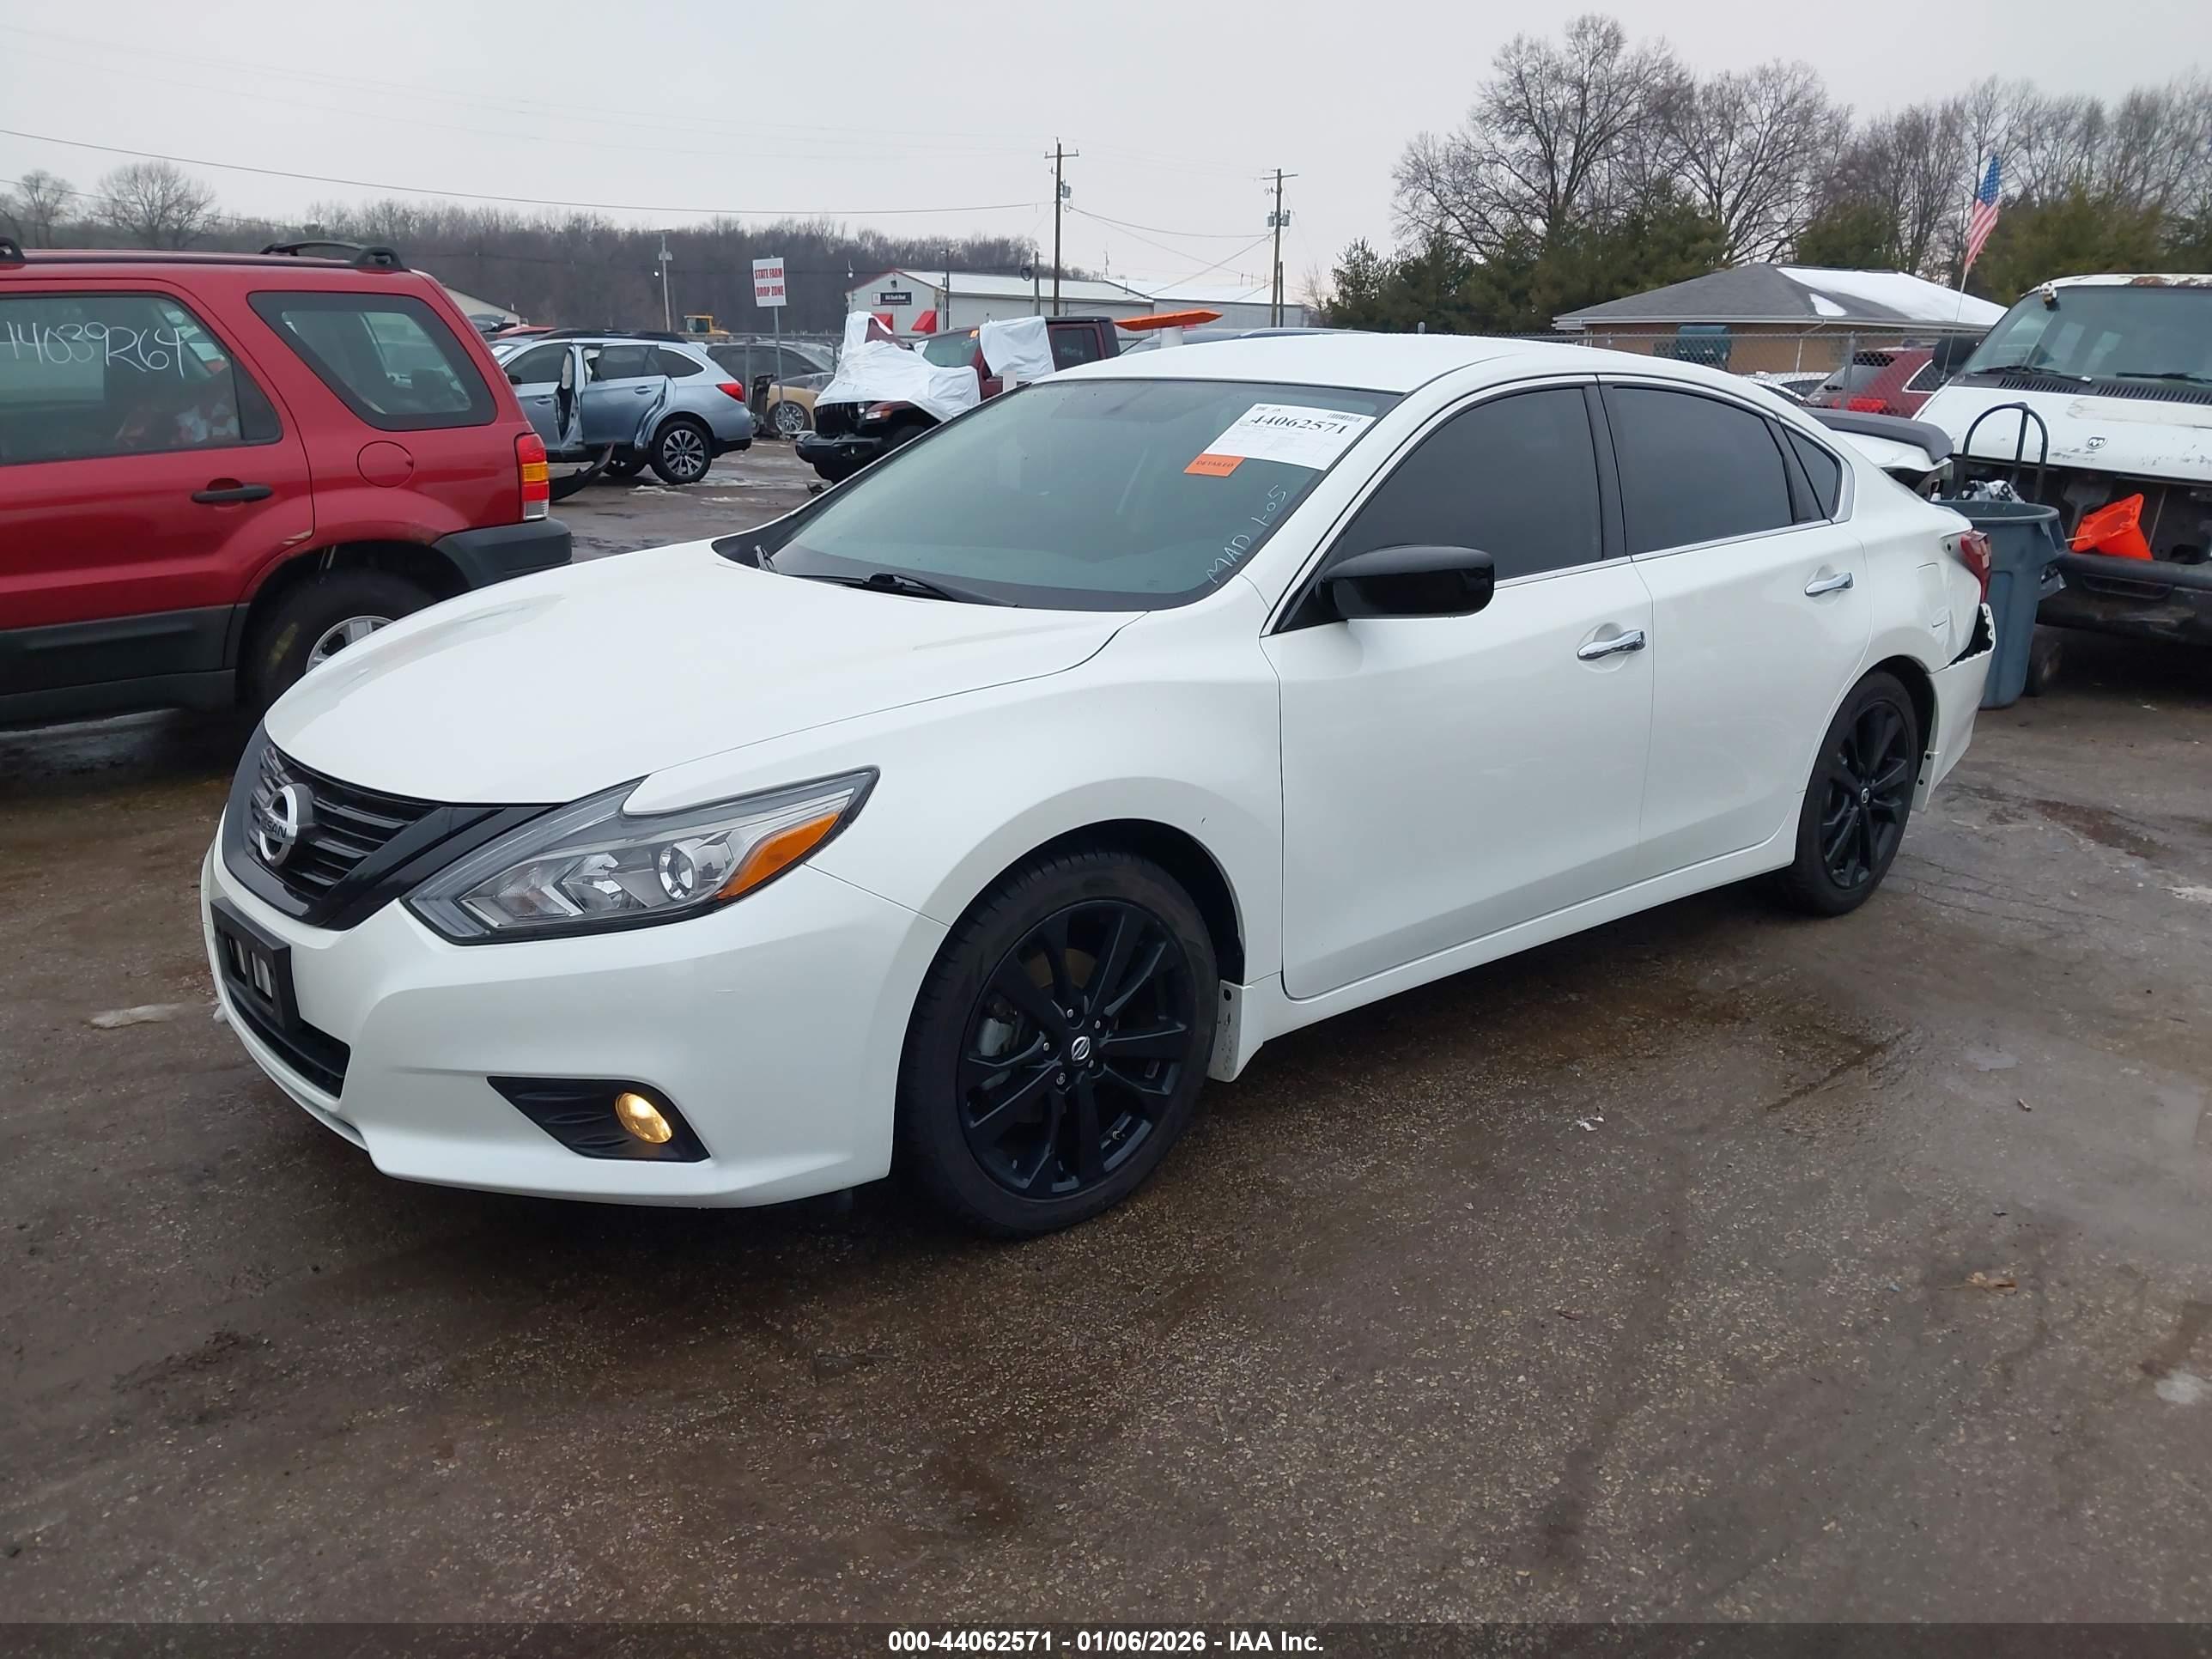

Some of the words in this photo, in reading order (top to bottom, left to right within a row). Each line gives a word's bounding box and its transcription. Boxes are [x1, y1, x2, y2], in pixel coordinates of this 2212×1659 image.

[755, 268, 769, 280] STATE
[769, 267, 783, 278] FARM
[757, 286, 770, 297] DROP
[771, 285, 785, 296] ZONE
[1249, 414, 1348, 434] 44062571
[1206, 534, 1251, 584] MAD
